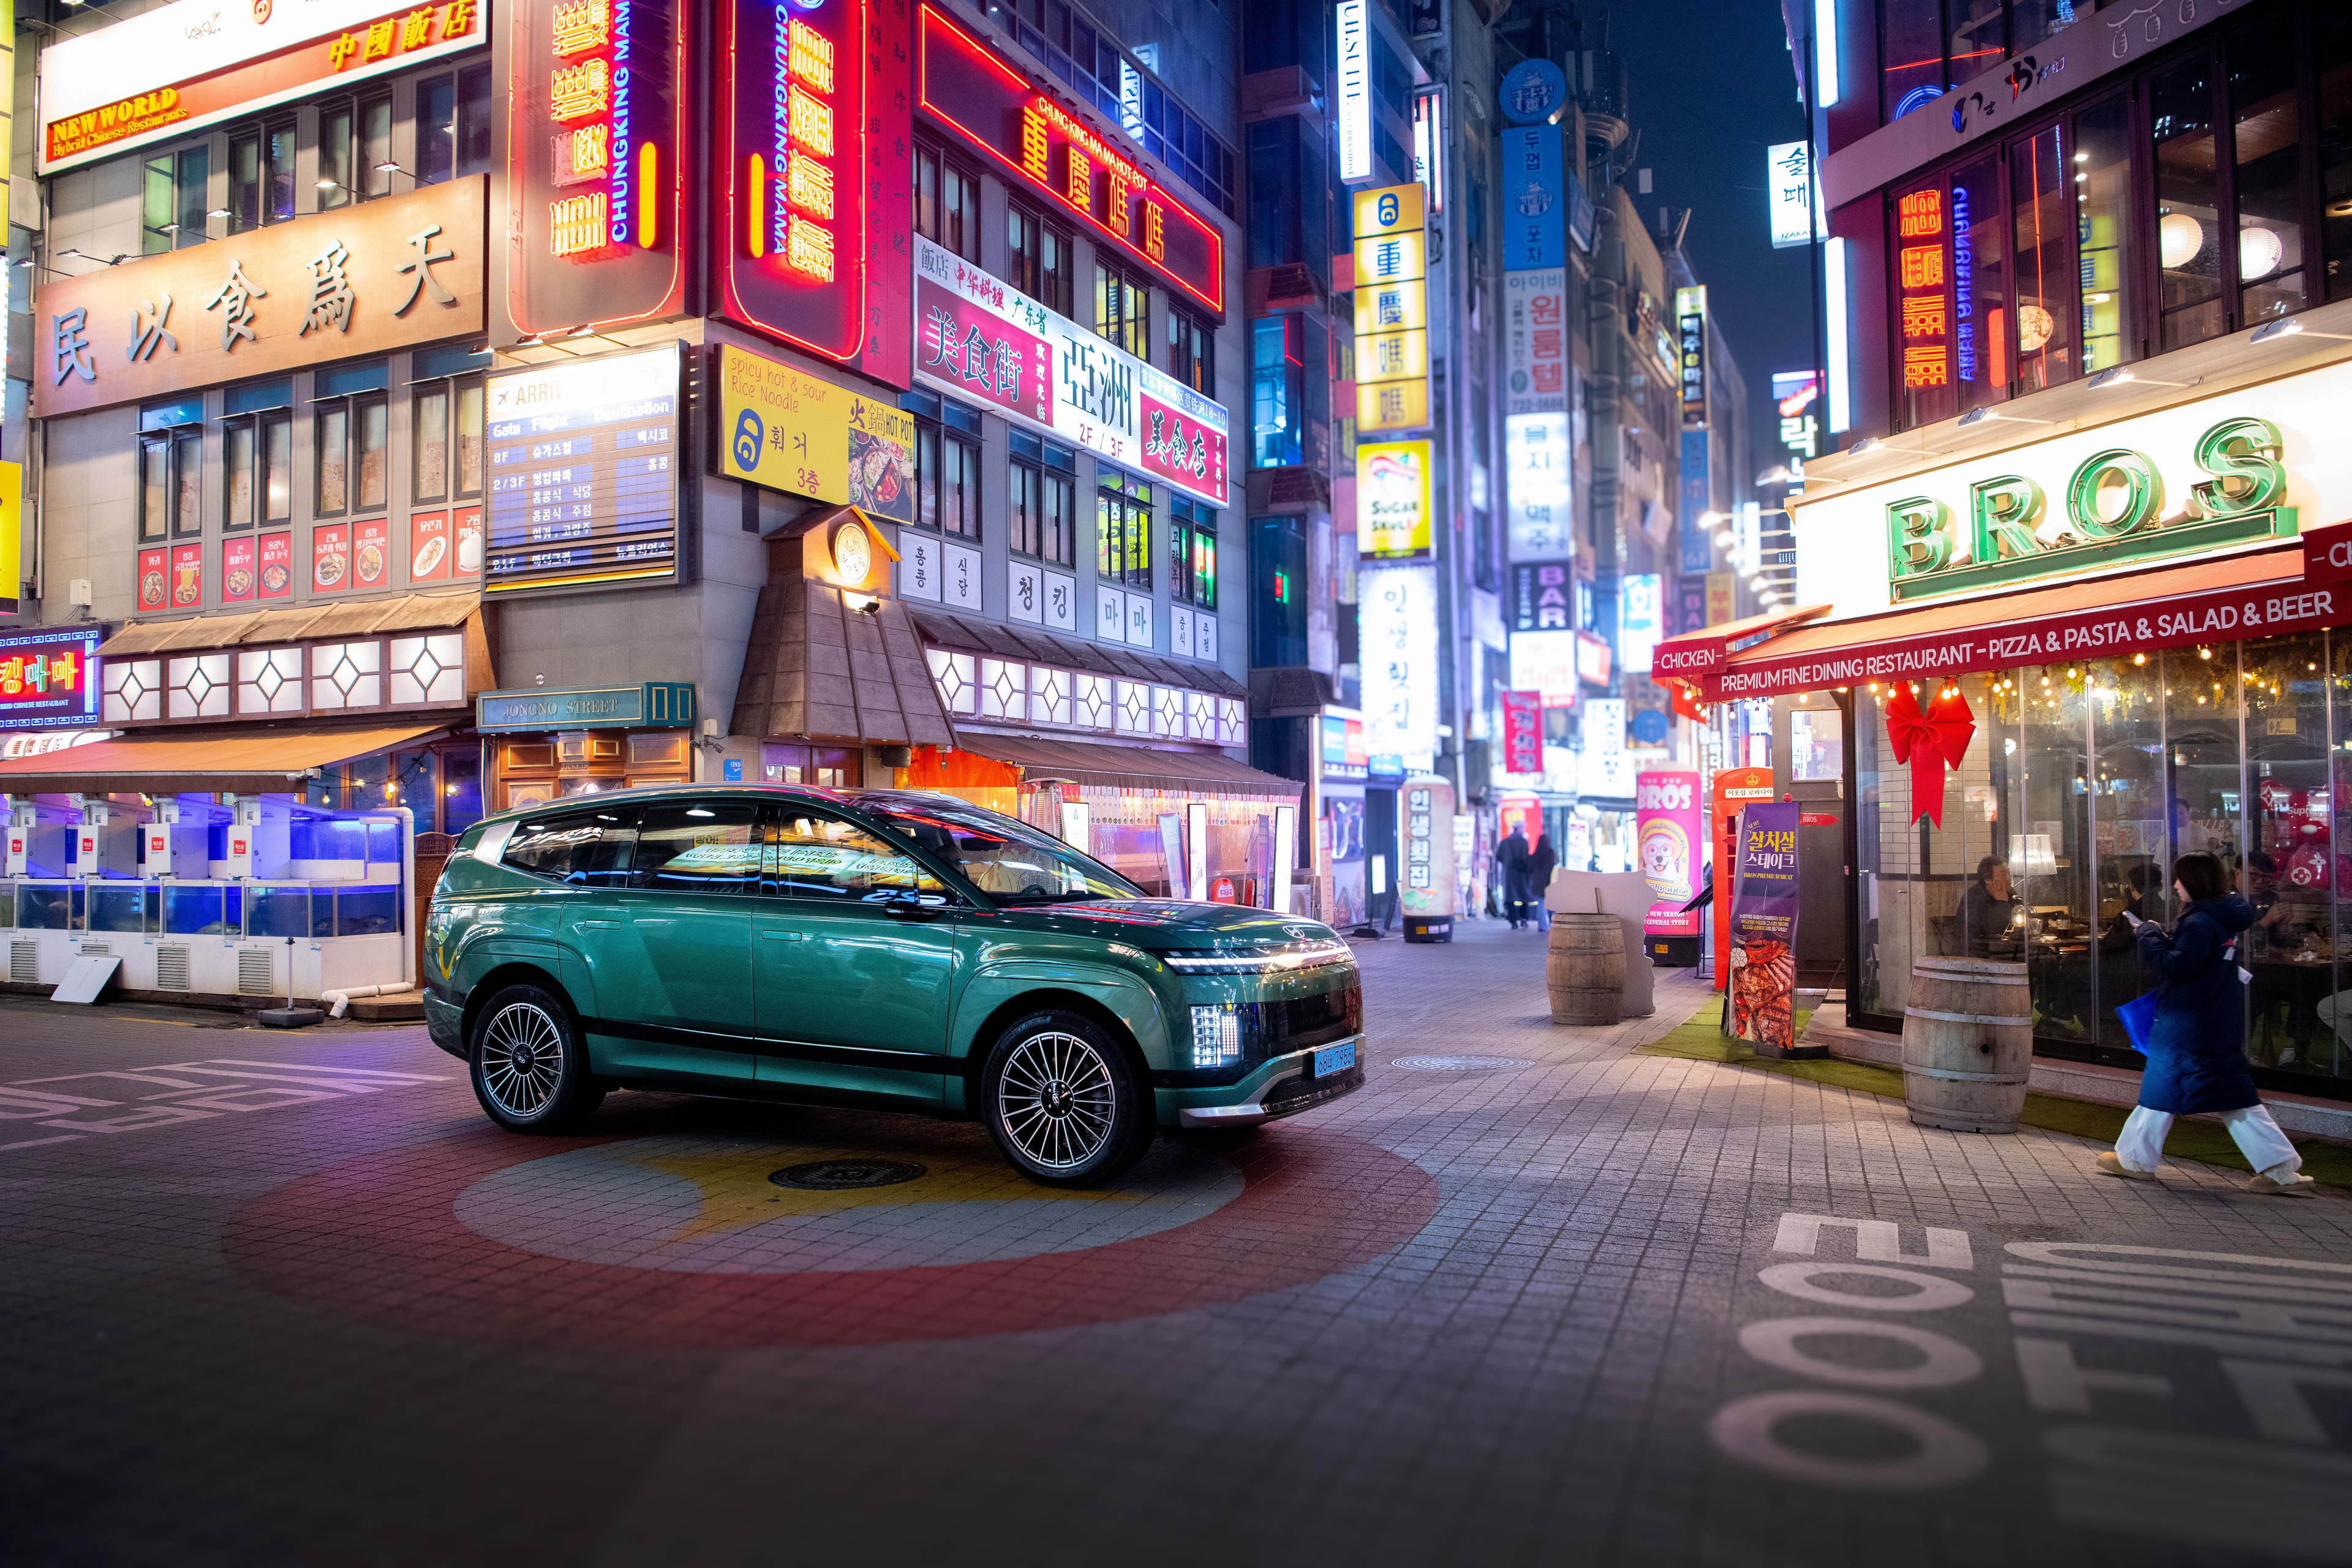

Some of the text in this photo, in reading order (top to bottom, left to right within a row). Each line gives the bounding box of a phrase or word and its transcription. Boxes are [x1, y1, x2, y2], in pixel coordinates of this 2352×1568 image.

[328, 0, 474, 71] 中國飯店
[53, 88, 178, 143] NEW WORLD
[53, 108, 188, 157] Hybrid Chinese Restaurants
[774, 4, 788, 254] CHUNGKING MAMA
[611, 66, 629, 243] CHUNGKING
[1038, 97, 1148, 191] CHUNG KING MA MA HOT POT
[1022, 105, 1164, 262] 重慶媽媽
[53, 224, 455, 386] 民以食爲天
[921, 244, 1047, 336] 飯店 中华料理 广东省
[925, 305, 1022, 402] 美食街
[731, 356, 826, 402] spicy hot & sour
[732, 375, 799, 413] Rice Noodle
[1035, 342, 1046, 422] 欢迎光临
[1062, 334, 1133, 437] 亞洲
[493, 400, 669, 438] Gate Flight Destination
[848, 398, 886, 437] 火鍋
[886, 414, 913, 443] HOT POT
[494, 451, 510, 464] 8F
[1079, 423, 1093, 445] 2F
[1111, 437, 1123, 459] 3F
[1146, 409, 1208, 481] 美食店
[493, 476, 526, 491] 2/3F
[647, 456, 669, 471] 홍콩
[797, 467, 820, 495] 3층
[532, 484, 592, 505] 홍콩식 식당
[532, 503, 592, 522] 홍콩식 주점
[1887, 417, 2286, 581] BROS
[1171, 530, 1180, 582] 고량주
[958, 557, 968, 598] 식당
[1538, 565, 1567, 628] BAR
[1017, 576, 1068, 619] 청킹
[1104, 597, 1147, 637] 마마
[1684, 594, 1704, 633] BA
[1178, 616, 1186, 647] 중식
[1202, 622, 1209, 653] 주점
[1721, 590, 2334, 693] PREMIUM FINE DINING RESTAURANT PIZZA & PASTA & SALAD & BEER
[36, 699, 69, 708] RESTAURANT
[503, 699, 618, 717] JONGNO STREET
[562, 762, 589, 771] TICKETS
[1637, 784, 1692, 810] BROS
[1728, 788, 1746, 797] 이웃집
[1744, 853, 1795, 870] 스테이크
[1747, 831, 1795, 853] 살치살
[1665, 884, 1688, 897] BROS
[1334, 1047, 1352, 1068] 7955
